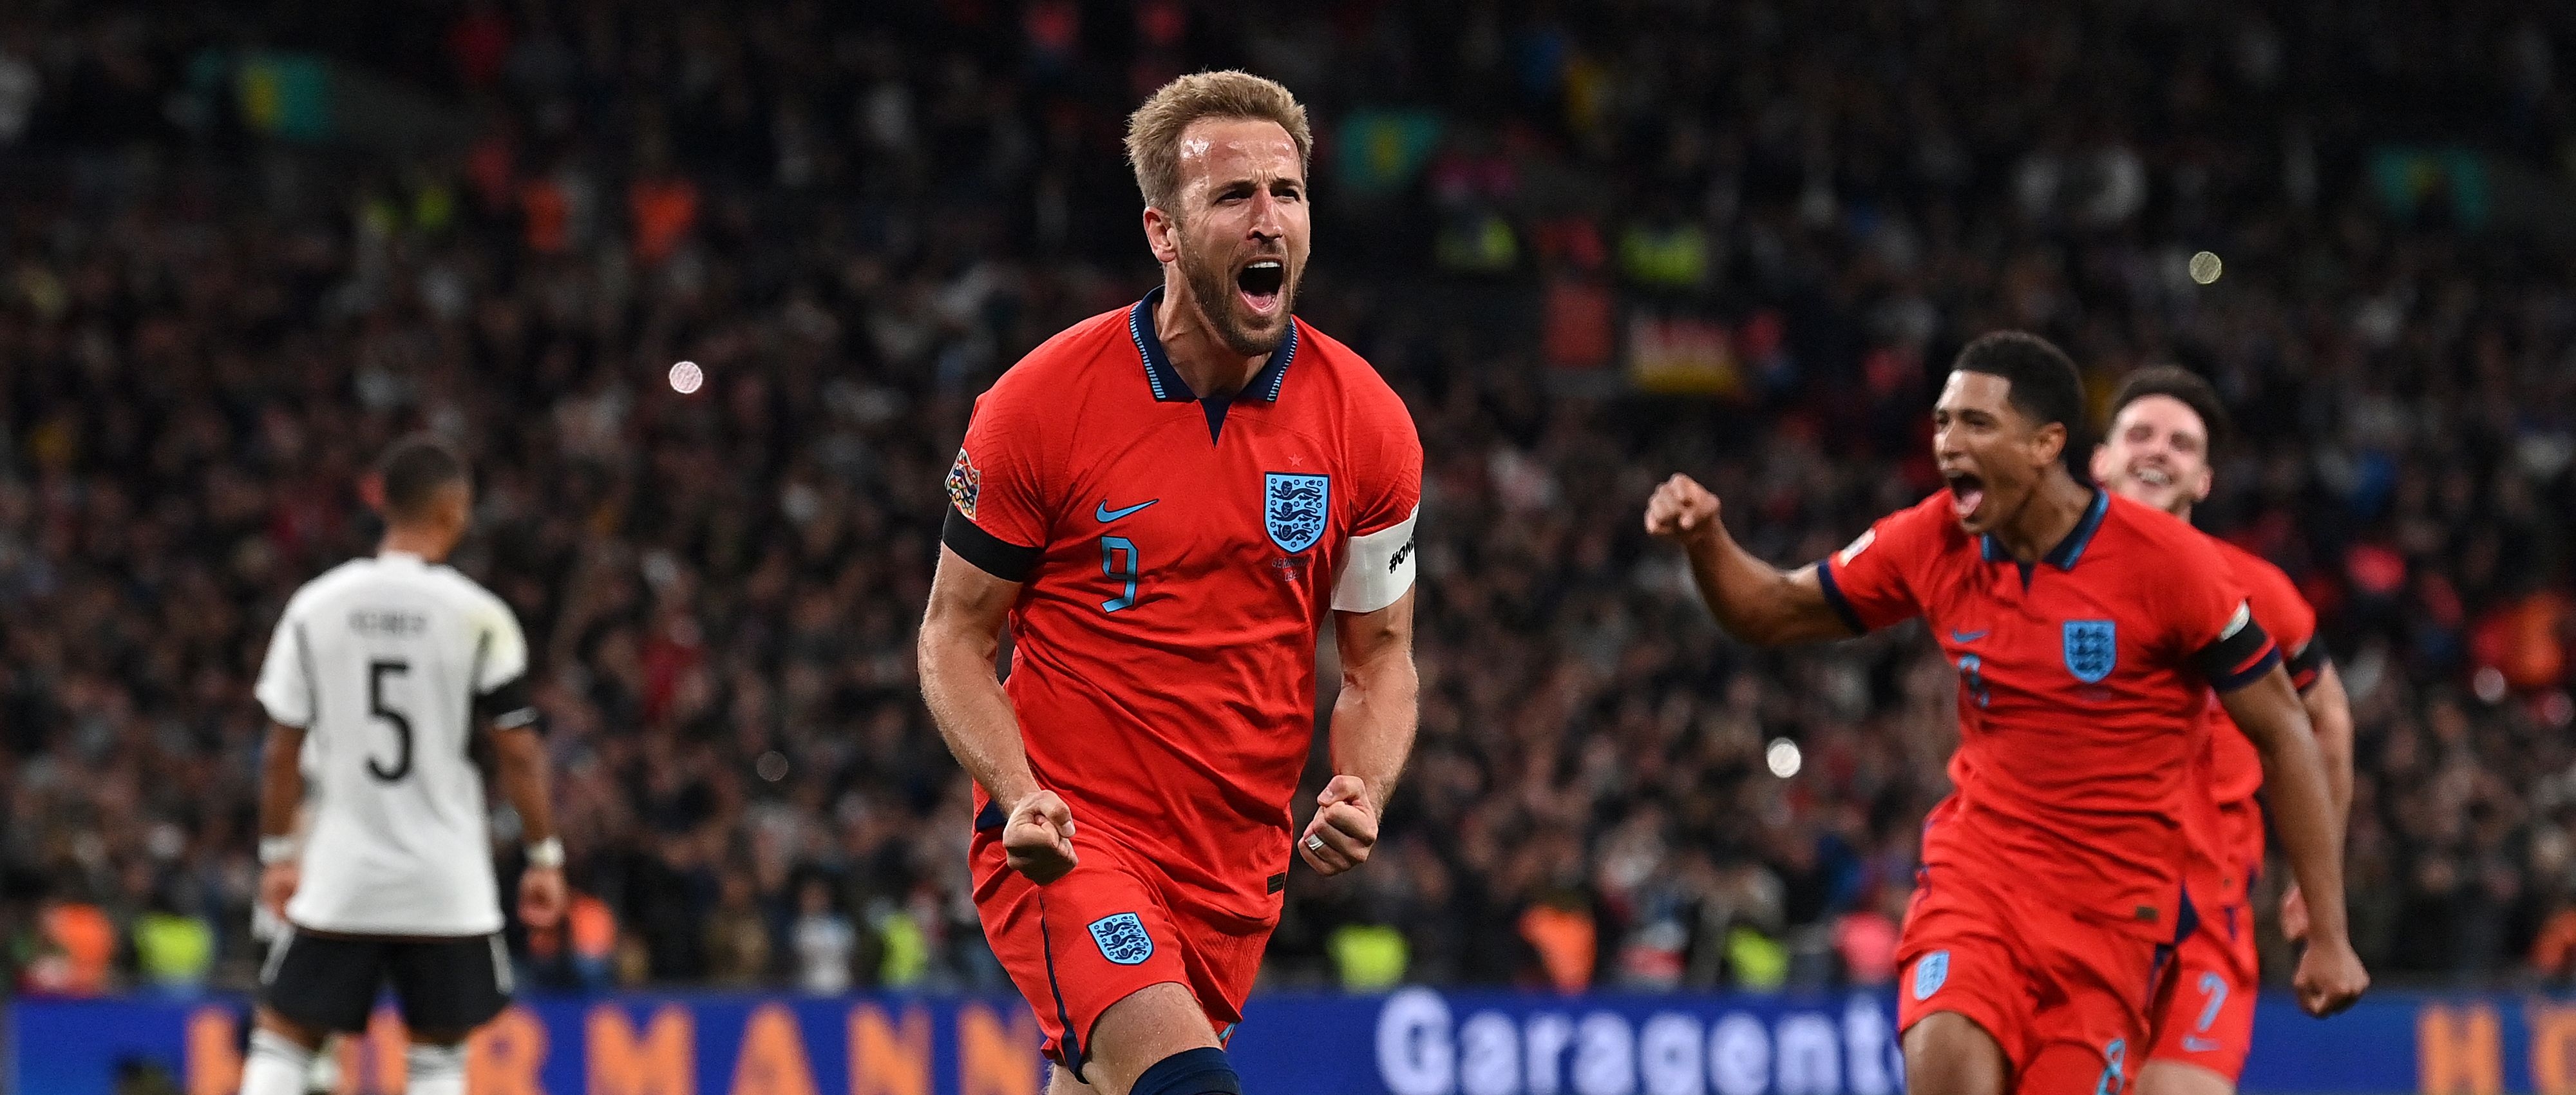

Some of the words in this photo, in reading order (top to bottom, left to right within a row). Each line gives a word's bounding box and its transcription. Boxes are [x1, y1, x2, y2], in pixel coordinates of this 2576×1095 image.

[1101, 535, 1139, 613] 9
[366, 656, 413, 782] 5
[2197, 972, 2229, 1032] 7
